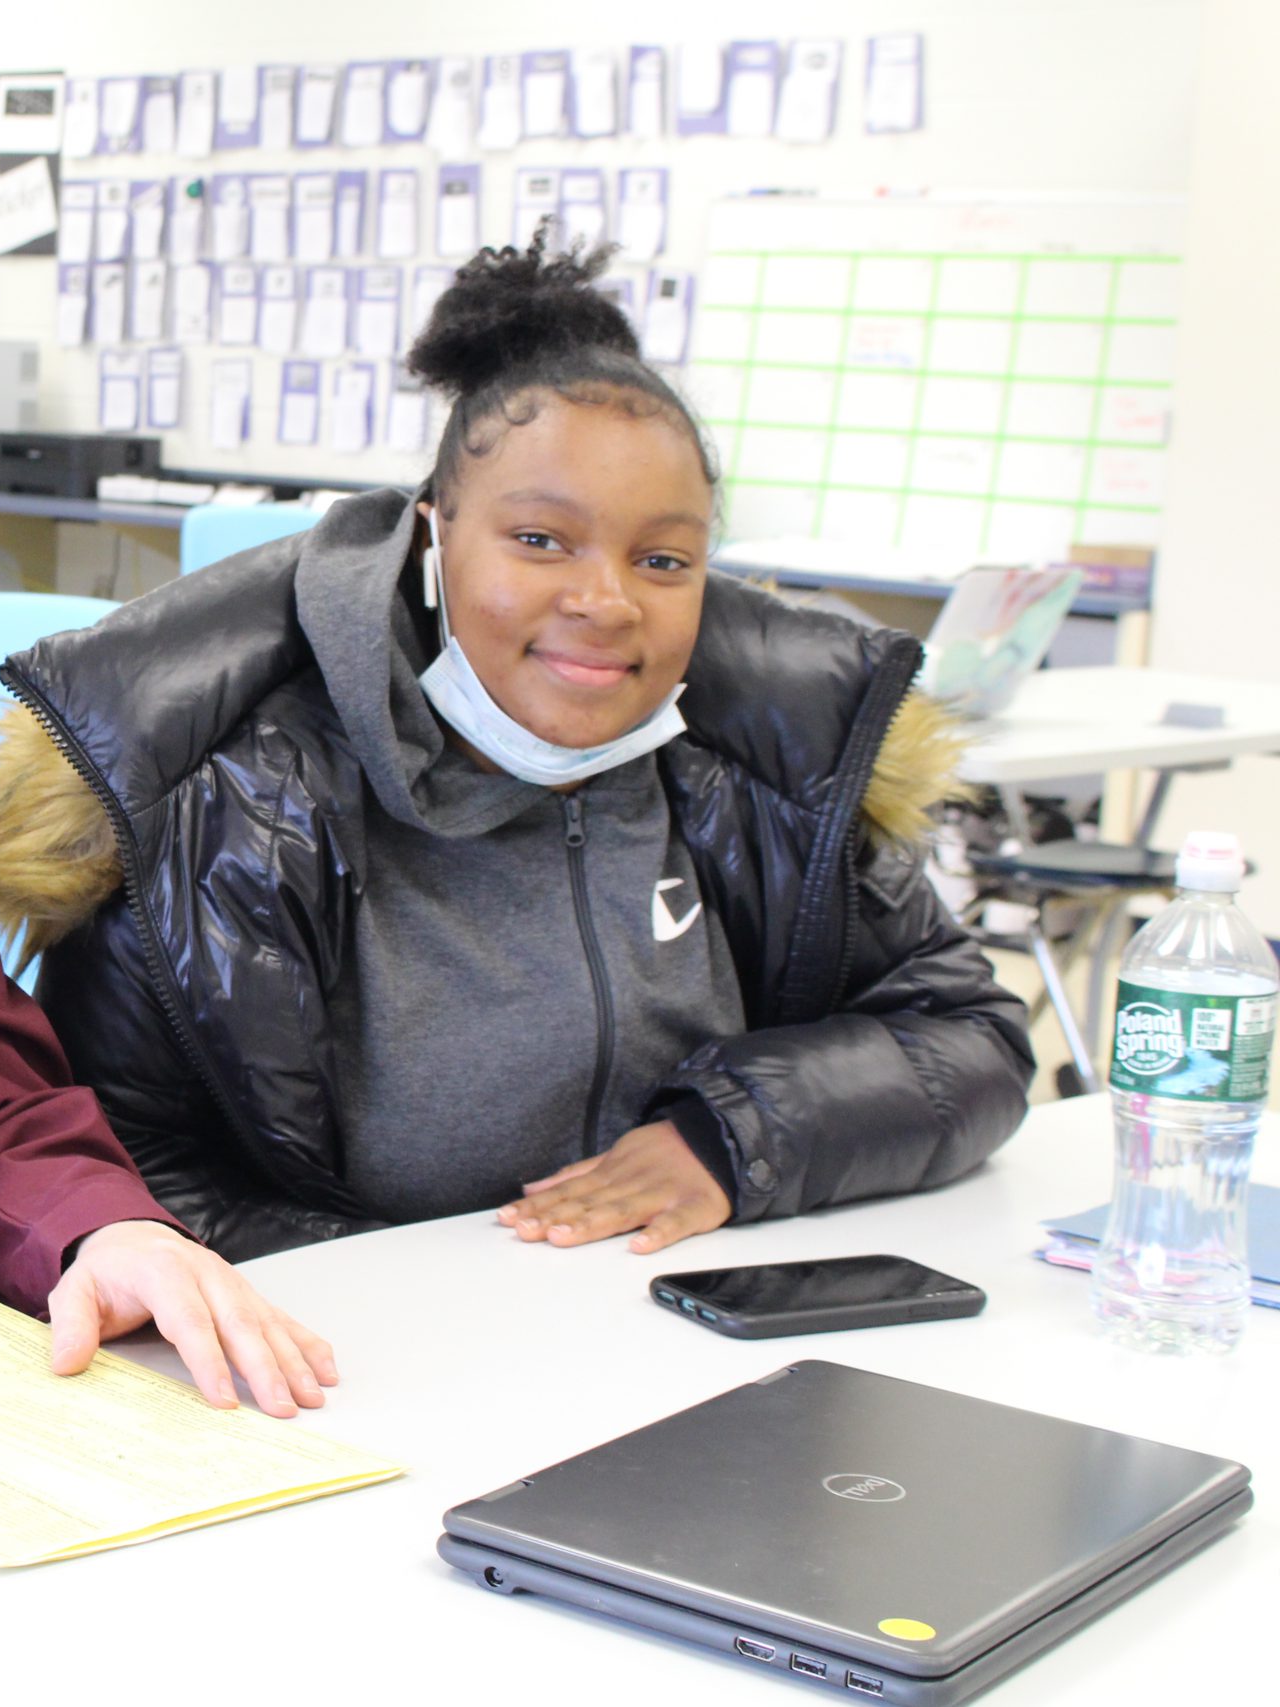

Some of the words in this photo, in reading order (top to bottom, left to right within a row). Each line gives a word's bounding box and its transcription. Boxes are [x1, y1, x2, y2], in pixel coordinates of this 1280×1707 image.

[1117, 1008, 1183, 1035] Poland
[1116, 1032, 1185, 1061] Spring
[842, 1478, 886, 1497] DELL
